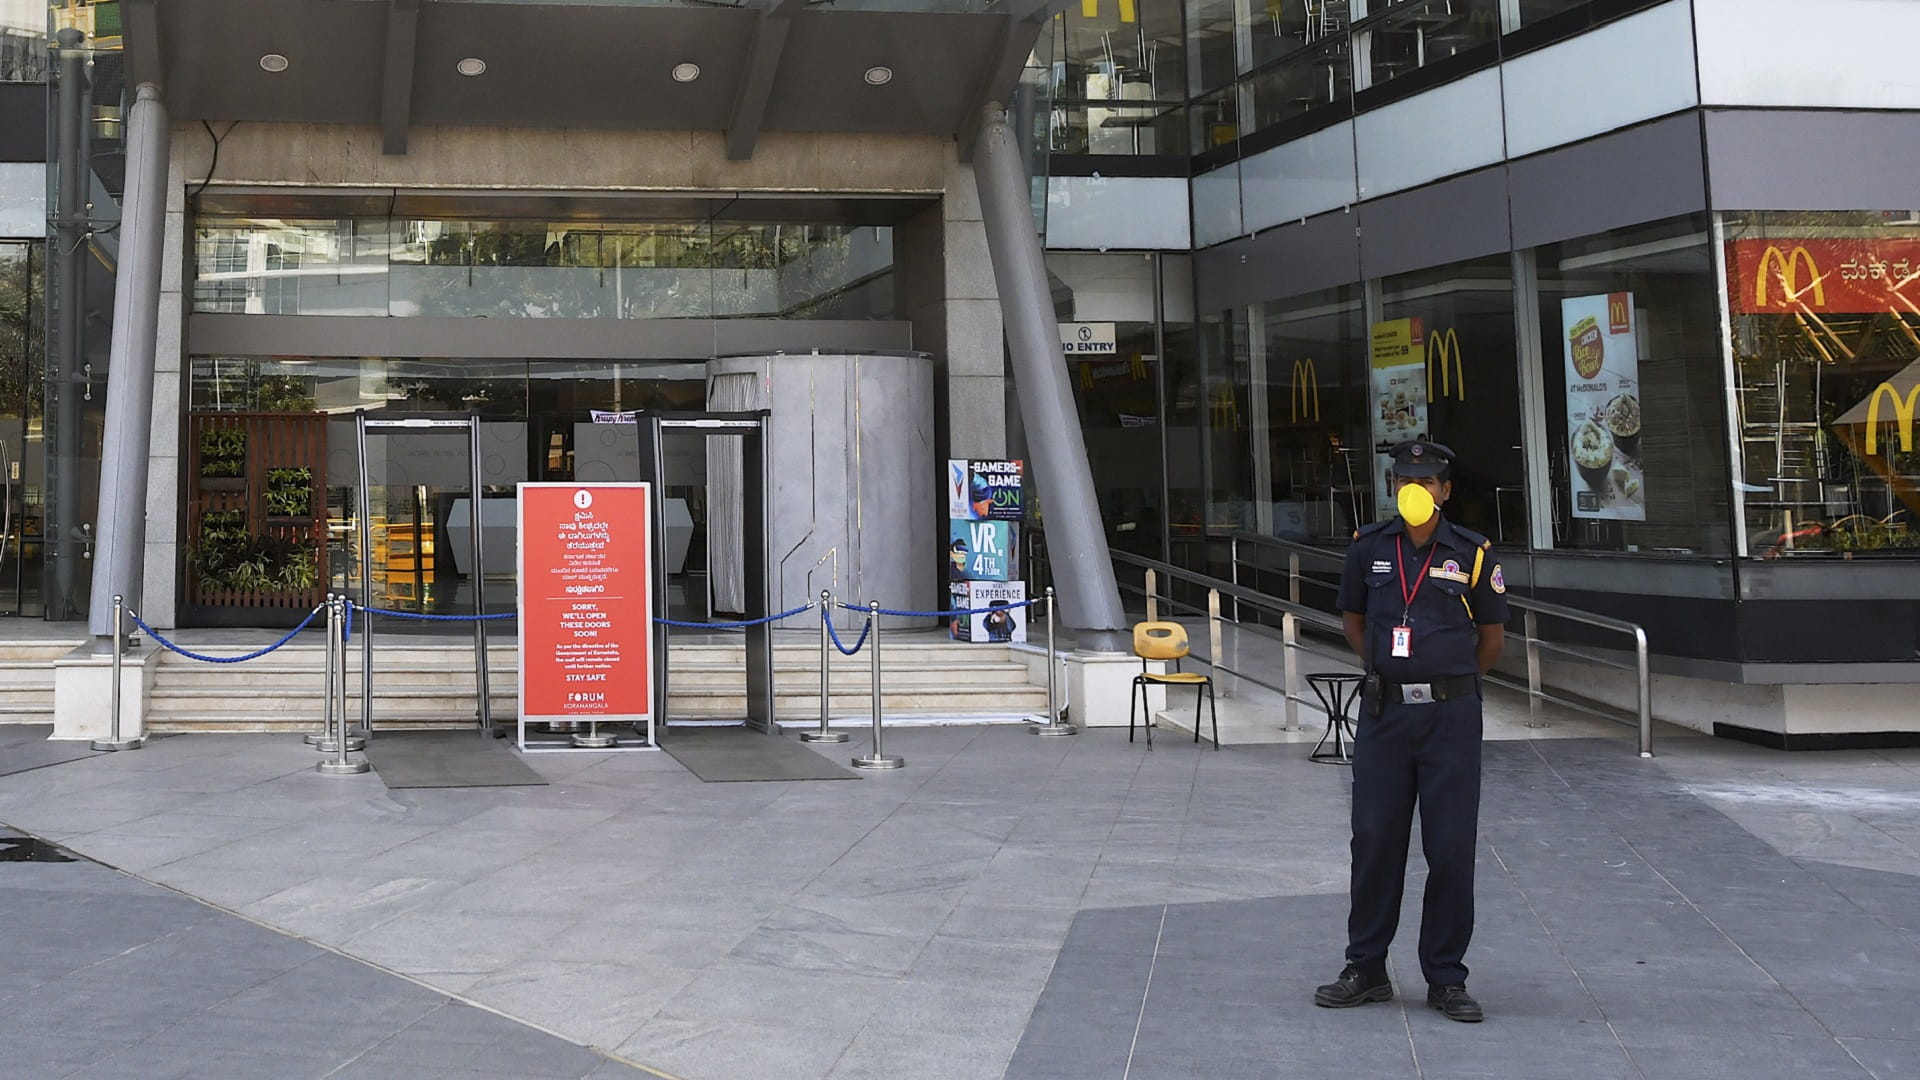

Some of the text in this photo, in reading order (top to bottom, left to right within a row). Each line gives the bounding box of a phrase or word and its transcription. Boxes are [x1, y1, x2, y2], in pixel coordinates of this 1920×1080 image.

[1078, 343, 1114, 351] ENTRY
[988, 475, 1021, 487] GAME
[973, 554, 996, 575] 4TH
[975, 590, 1021, 599] EXPERIENCE
[569, 693, 604, 701] FORUM
